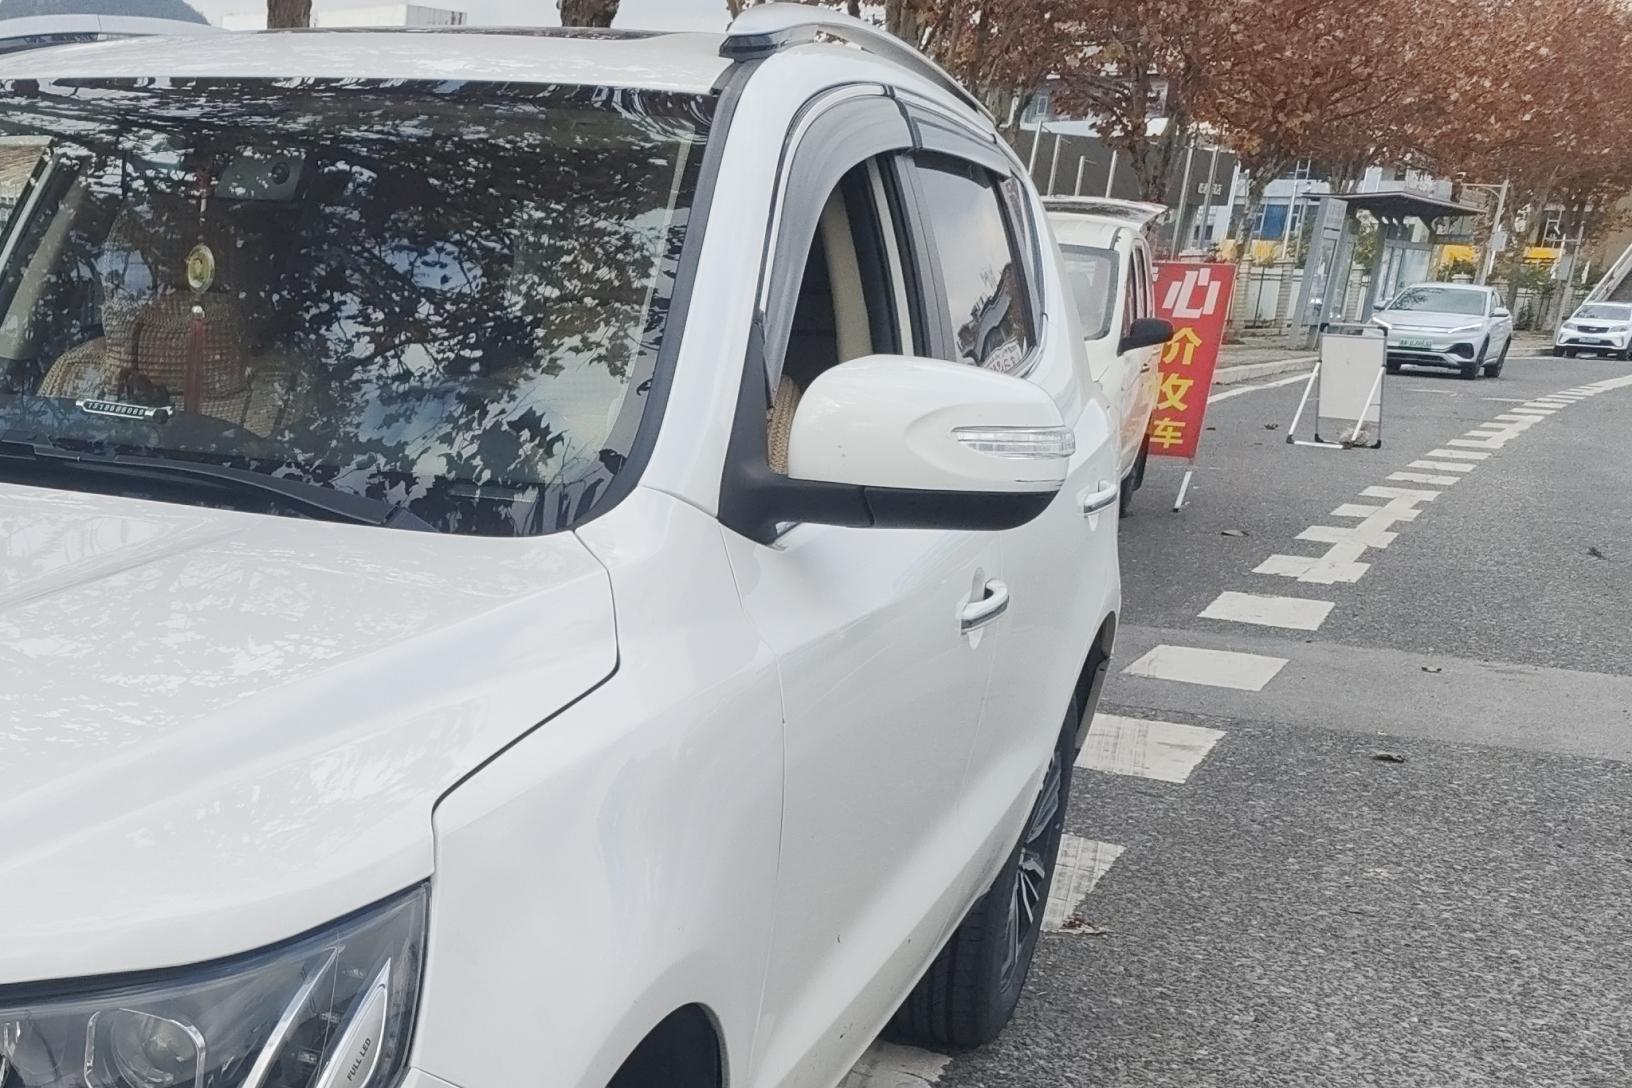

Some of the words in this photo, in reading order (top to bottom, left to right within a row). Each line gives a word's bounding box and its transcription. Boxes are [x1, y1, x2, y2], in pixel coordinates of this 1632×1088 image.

[1152, 267, 1221, 319] 心
[347, 1058, 362, 1081] FULL
[360, 1038, 371, 1057] LED
